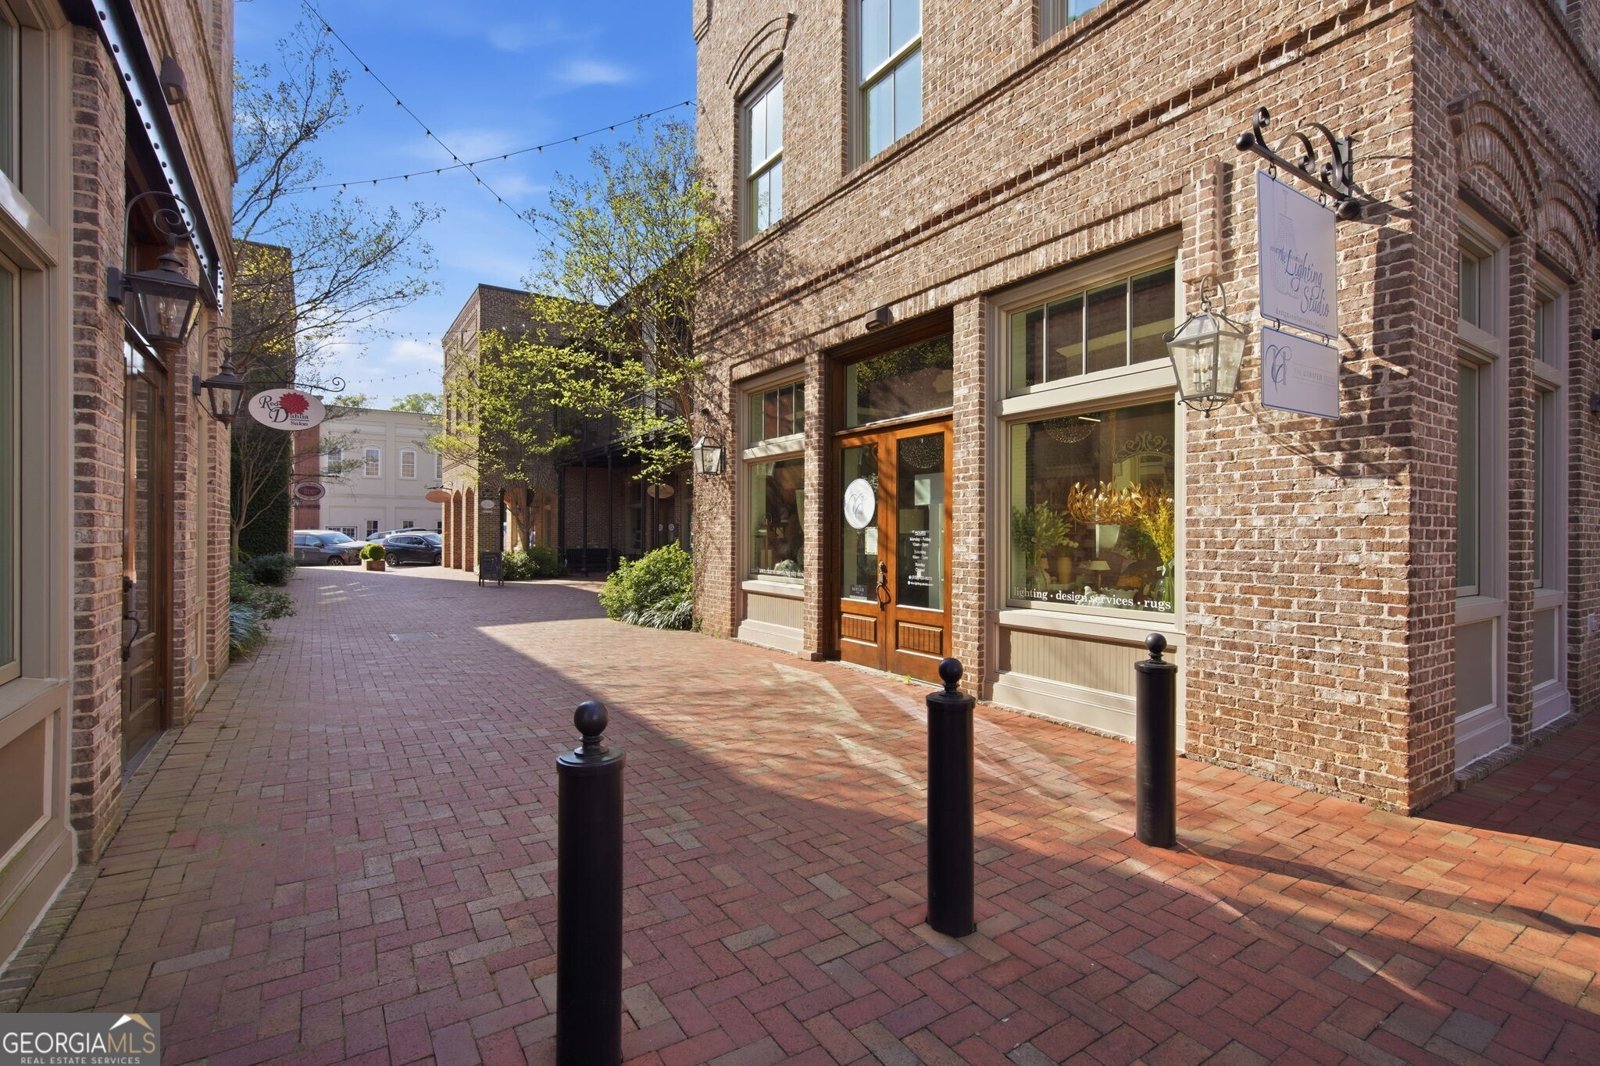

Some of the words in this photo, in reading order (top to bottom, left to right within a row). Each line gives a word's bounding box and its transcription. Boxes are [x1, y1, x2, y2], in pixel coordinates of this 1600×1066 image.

[1284, 249, 1323, 299] Lighting
[1300, 286, 1330, 317] Studio
[259, 395, 280, 412] Red
[269, 407, 309, 422] Dahlia
[1013, 586, 1048, 601] lighting
[1055, 590, 1088, 604] design
[1089, 593, 1134, 607] services
[1144, 599, 1172, 611] rugs
